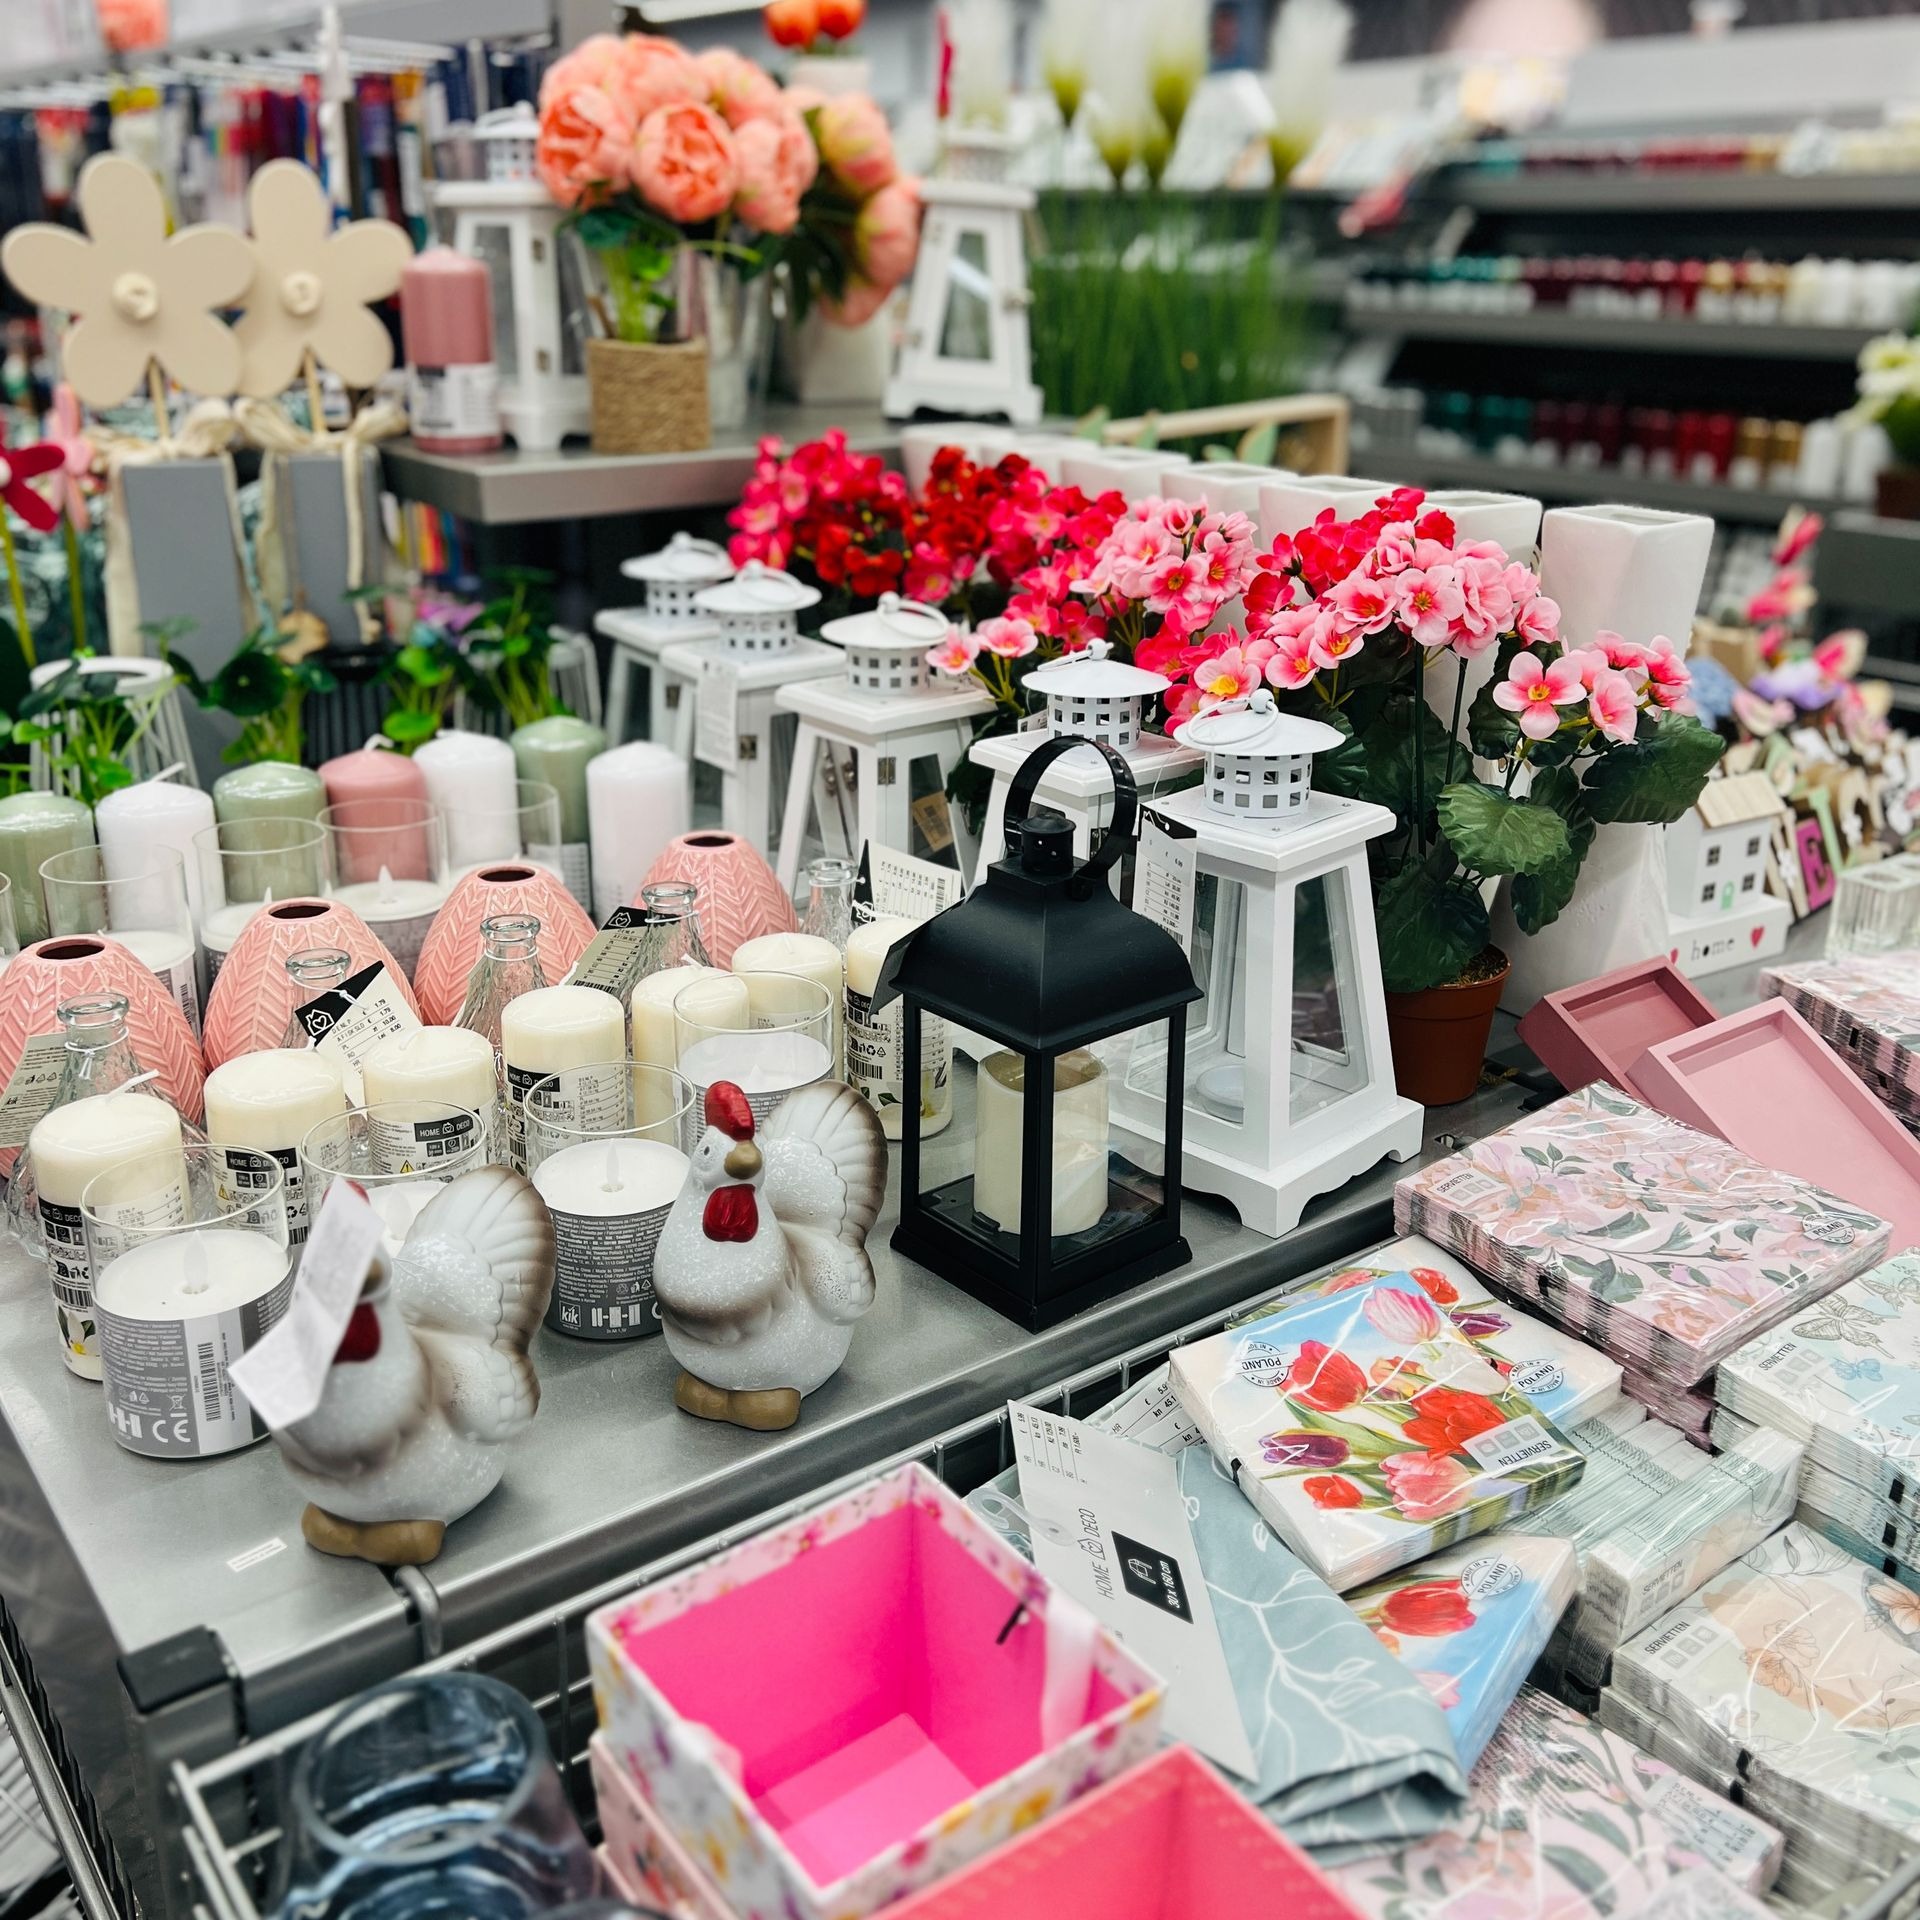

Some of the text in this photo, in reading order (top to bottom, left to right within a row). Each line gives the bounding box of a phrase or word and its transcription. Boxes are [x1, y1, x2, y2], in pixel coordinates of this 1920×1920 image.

[1691, 938, 1735, 962] home
[420, 1120, 470, 1137] HOME DECO
[230, 1159, 248, 1167] HOME
[1436, 1173, 1474, 1193] SERVIETTEN
[1812, 1221, 1845, 1236] POLAND
[561, 1305, 579, 1324] kik
[1242, 1357, 1281, 1370] POLAND
[1758, 1342, 1797, 1371] SERVIETTEN
[1518, 1364, 1554, 1387] POLAND
[1153, 1408, 1163, 1418] kn
[1112, 1423, 1123, 1433] HR
[1182, 1433, 1193, 1442] kn
[1498, 1440, 1552, 1467] SERVIETTEN
[1079, 1508, 1115, 1600] HOME DECO
[1160, 1560, 1171, 1574] cm
[1477, 1563, 1507, 1593] POLAND
[1644, 1621, 1690, 1655] SERVIETTEN
